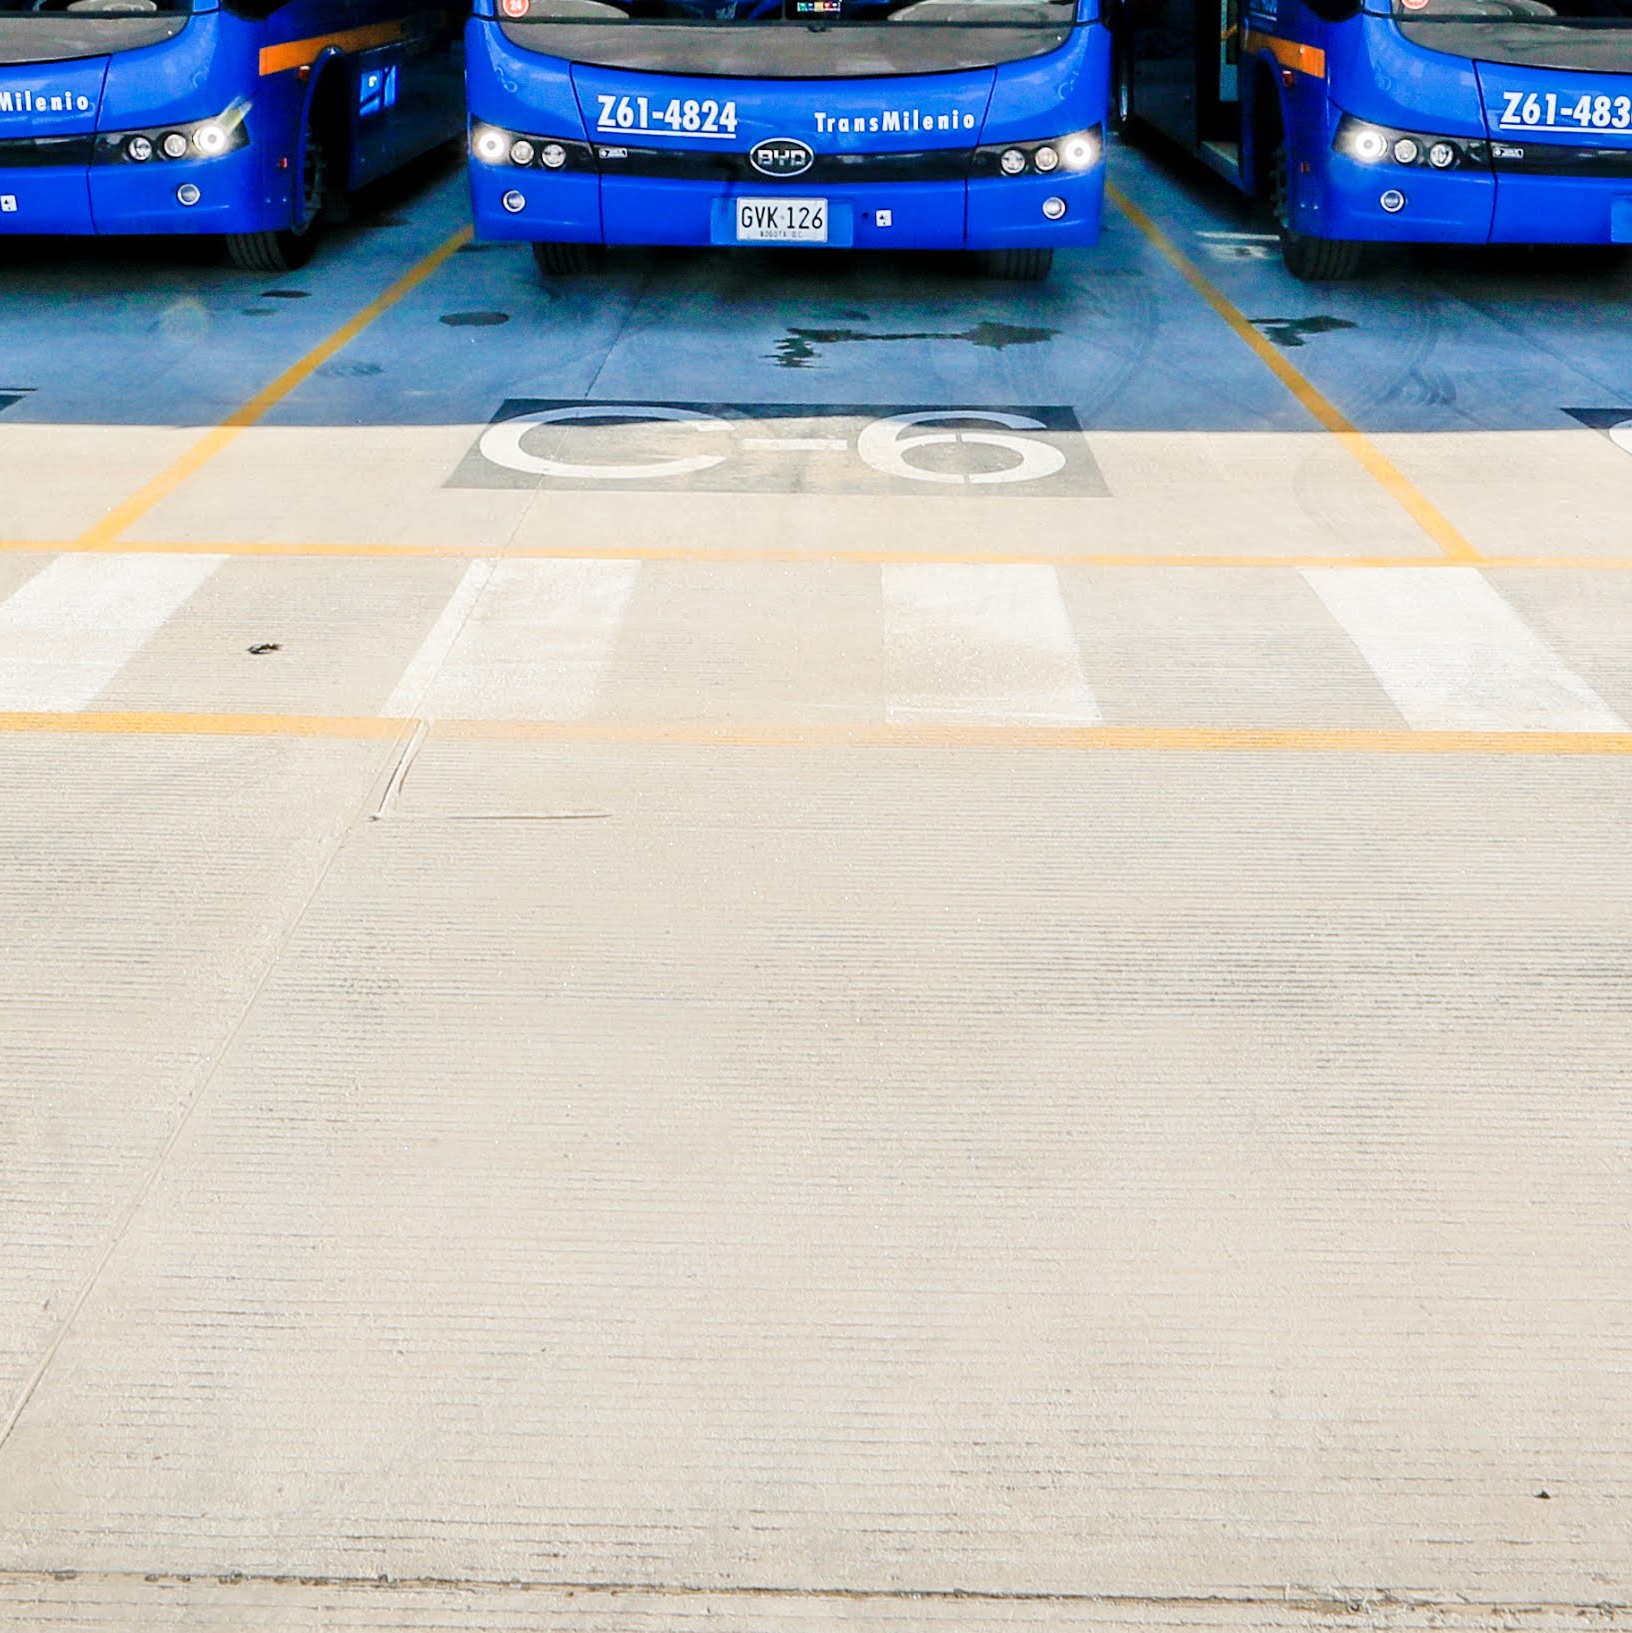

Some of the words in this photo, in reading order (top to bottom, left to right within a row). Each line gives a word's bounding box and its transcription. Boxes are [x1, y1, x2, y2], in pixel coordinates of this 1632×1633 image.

[597, 94, 738, 133] Z61-4824
[814, 109, 976, 134] TransMilenio
[757, 148, 807, 167] BYD
[479, 405, 1069, 485] C-6
